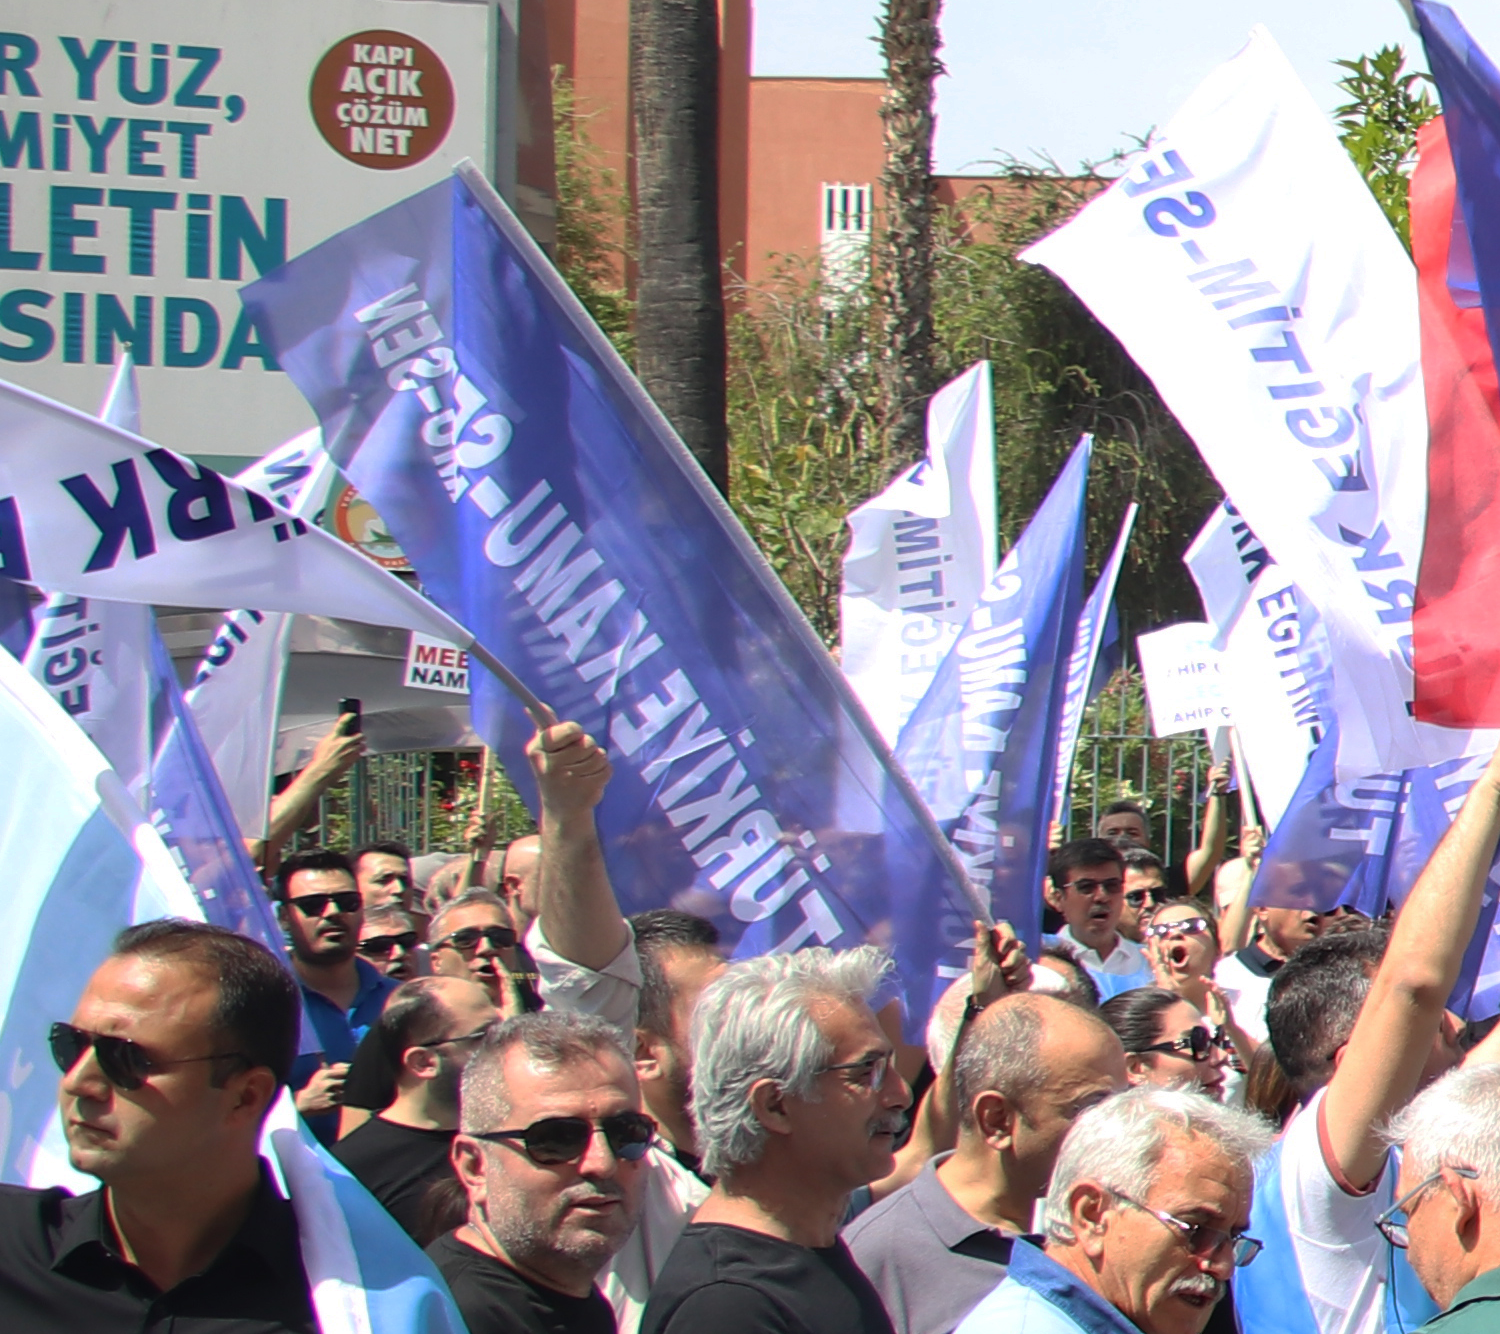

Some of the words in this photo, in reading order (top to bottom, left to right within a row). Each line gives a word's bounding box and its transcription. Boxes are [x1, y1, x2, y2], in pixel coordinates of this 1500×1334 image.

[353, 43, 414, 66] KAPI
[58, 36, 247, 124] YÜZ,
[340, 66, 424, 103] AÇIK
[336, 98, 430, 128] ÇÖZÜM
[350, 126, 414, 156] NET
